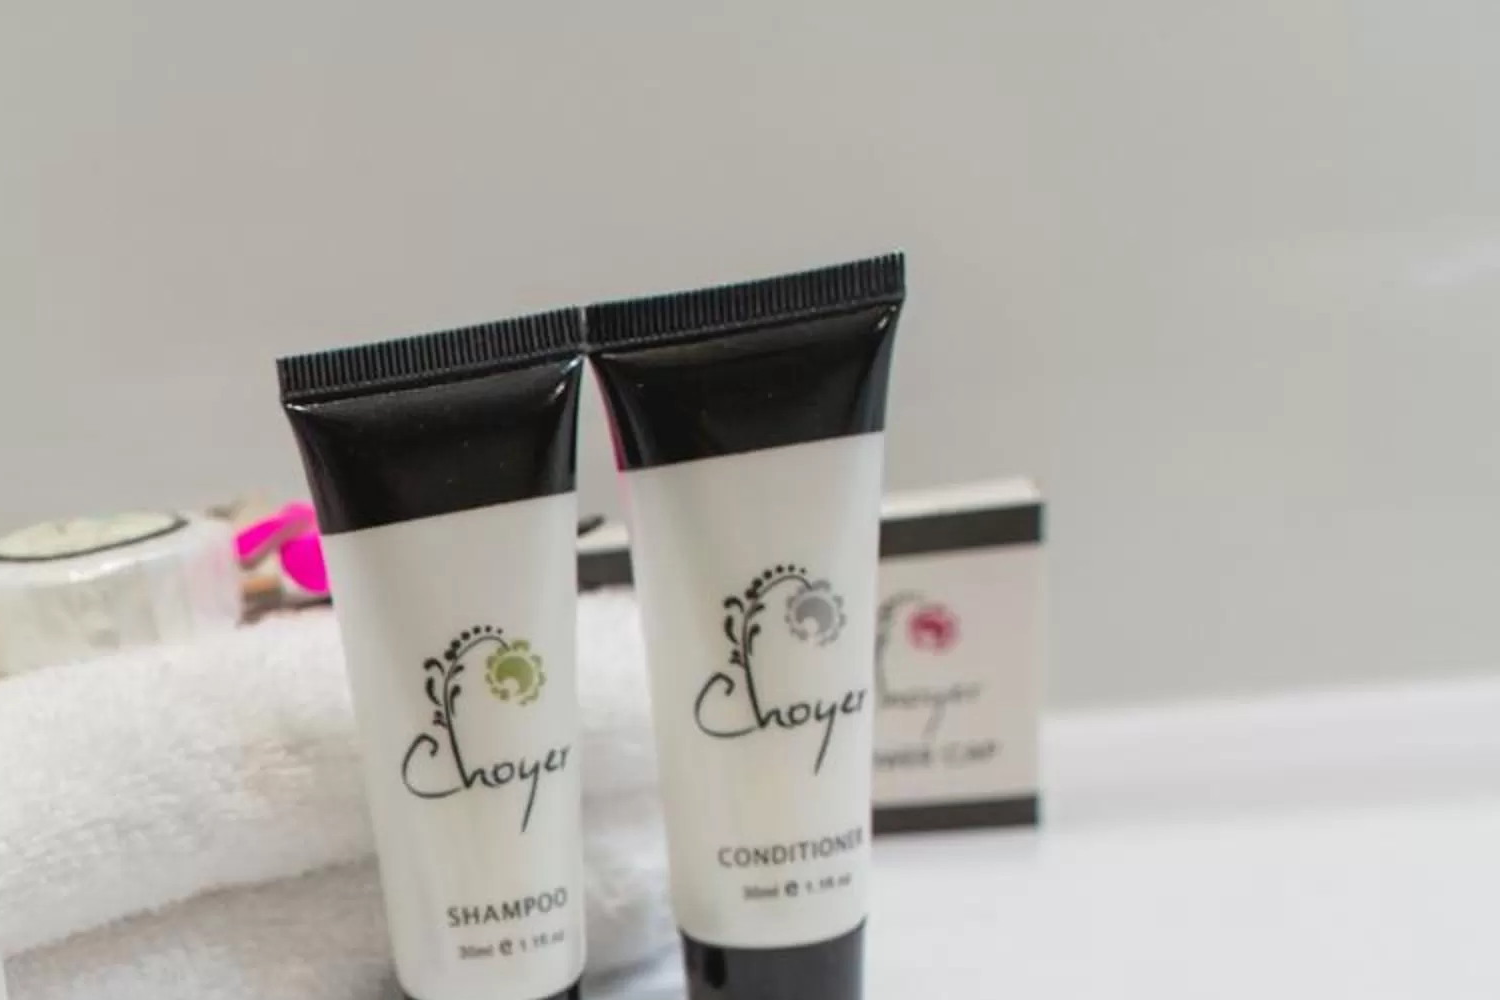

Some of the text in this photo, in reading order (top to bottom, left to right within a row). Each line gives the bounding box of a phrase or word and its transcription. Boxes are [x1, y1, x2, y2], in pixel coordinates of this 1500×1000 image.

[401, 712, 572, 833] Choyer
[693, 655, 867, 777] Choyer
[446, 886, 569, 929] SHAMPOO
